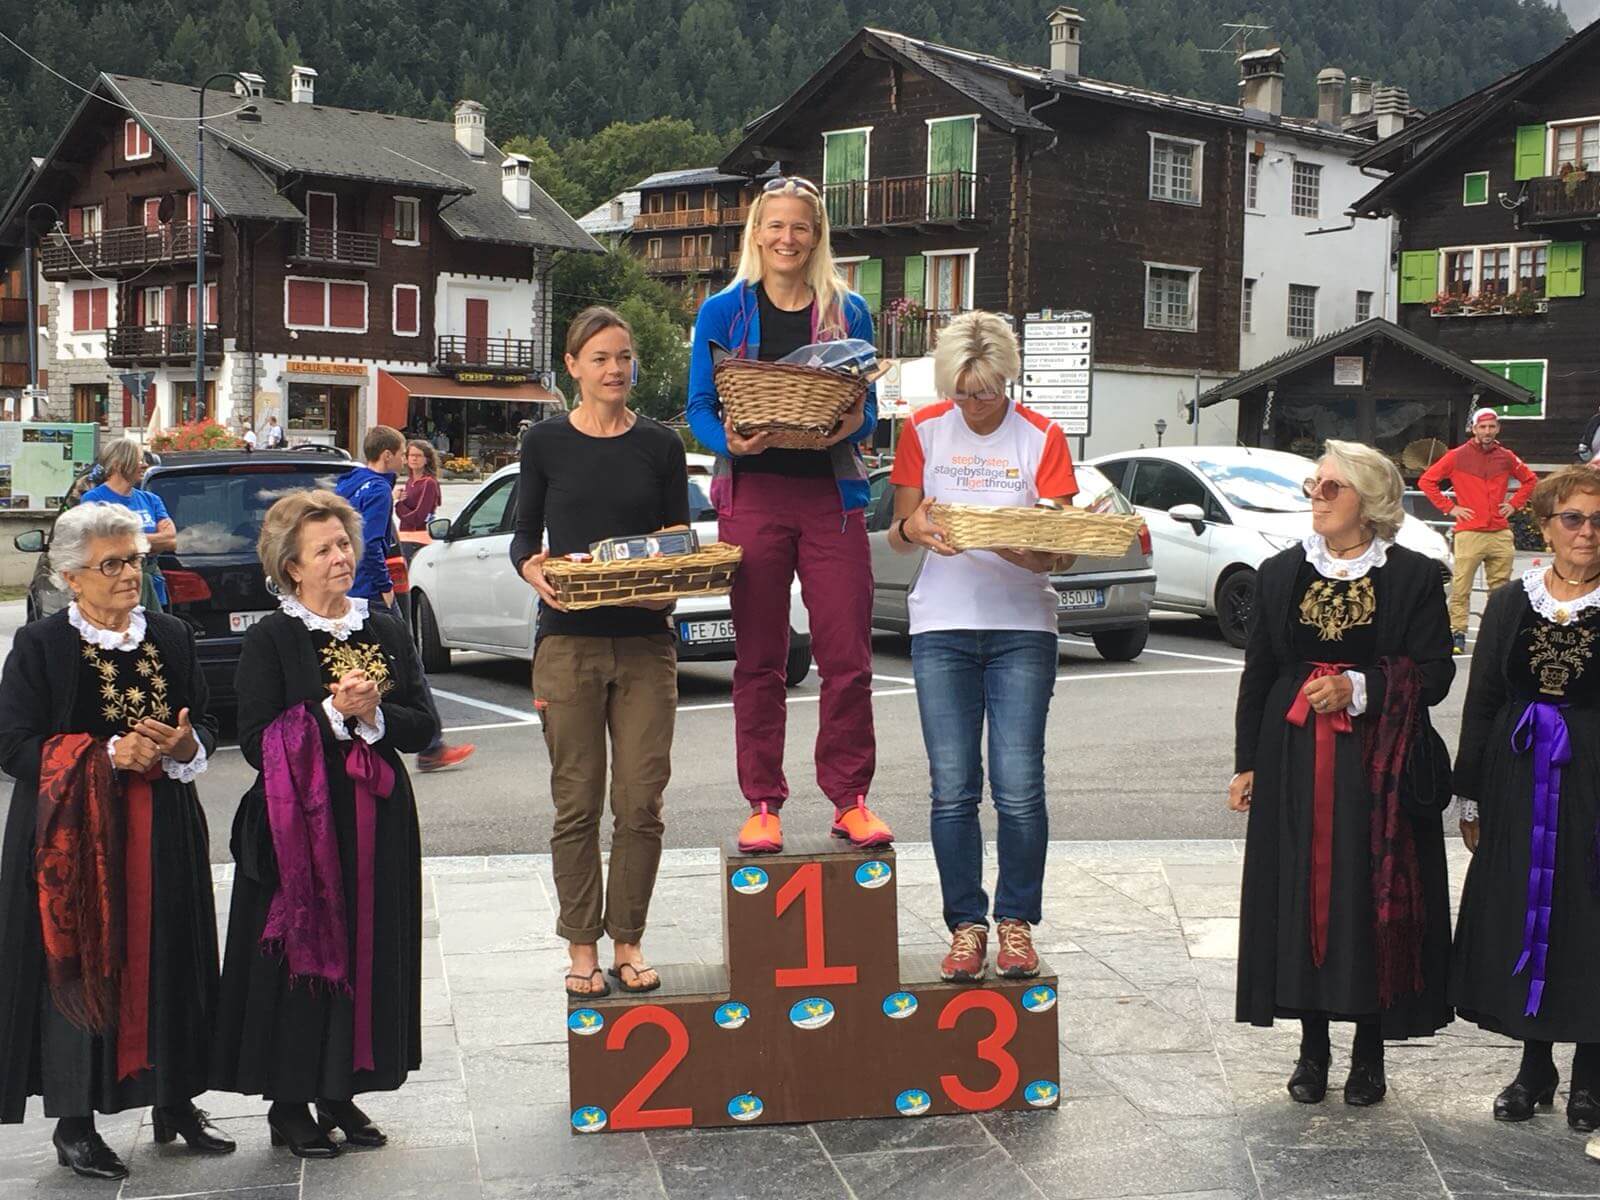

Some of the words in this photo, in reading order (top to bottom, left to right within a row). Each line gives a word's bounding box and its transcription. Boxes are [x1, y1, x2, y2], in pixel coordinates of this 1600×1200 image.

[934, 464, 1004, 478] stagebystage
[775, 863, 857, 987] 1
[605, 1005, 692, 1130] 2
[937, 990, 1019, 1110] 3
